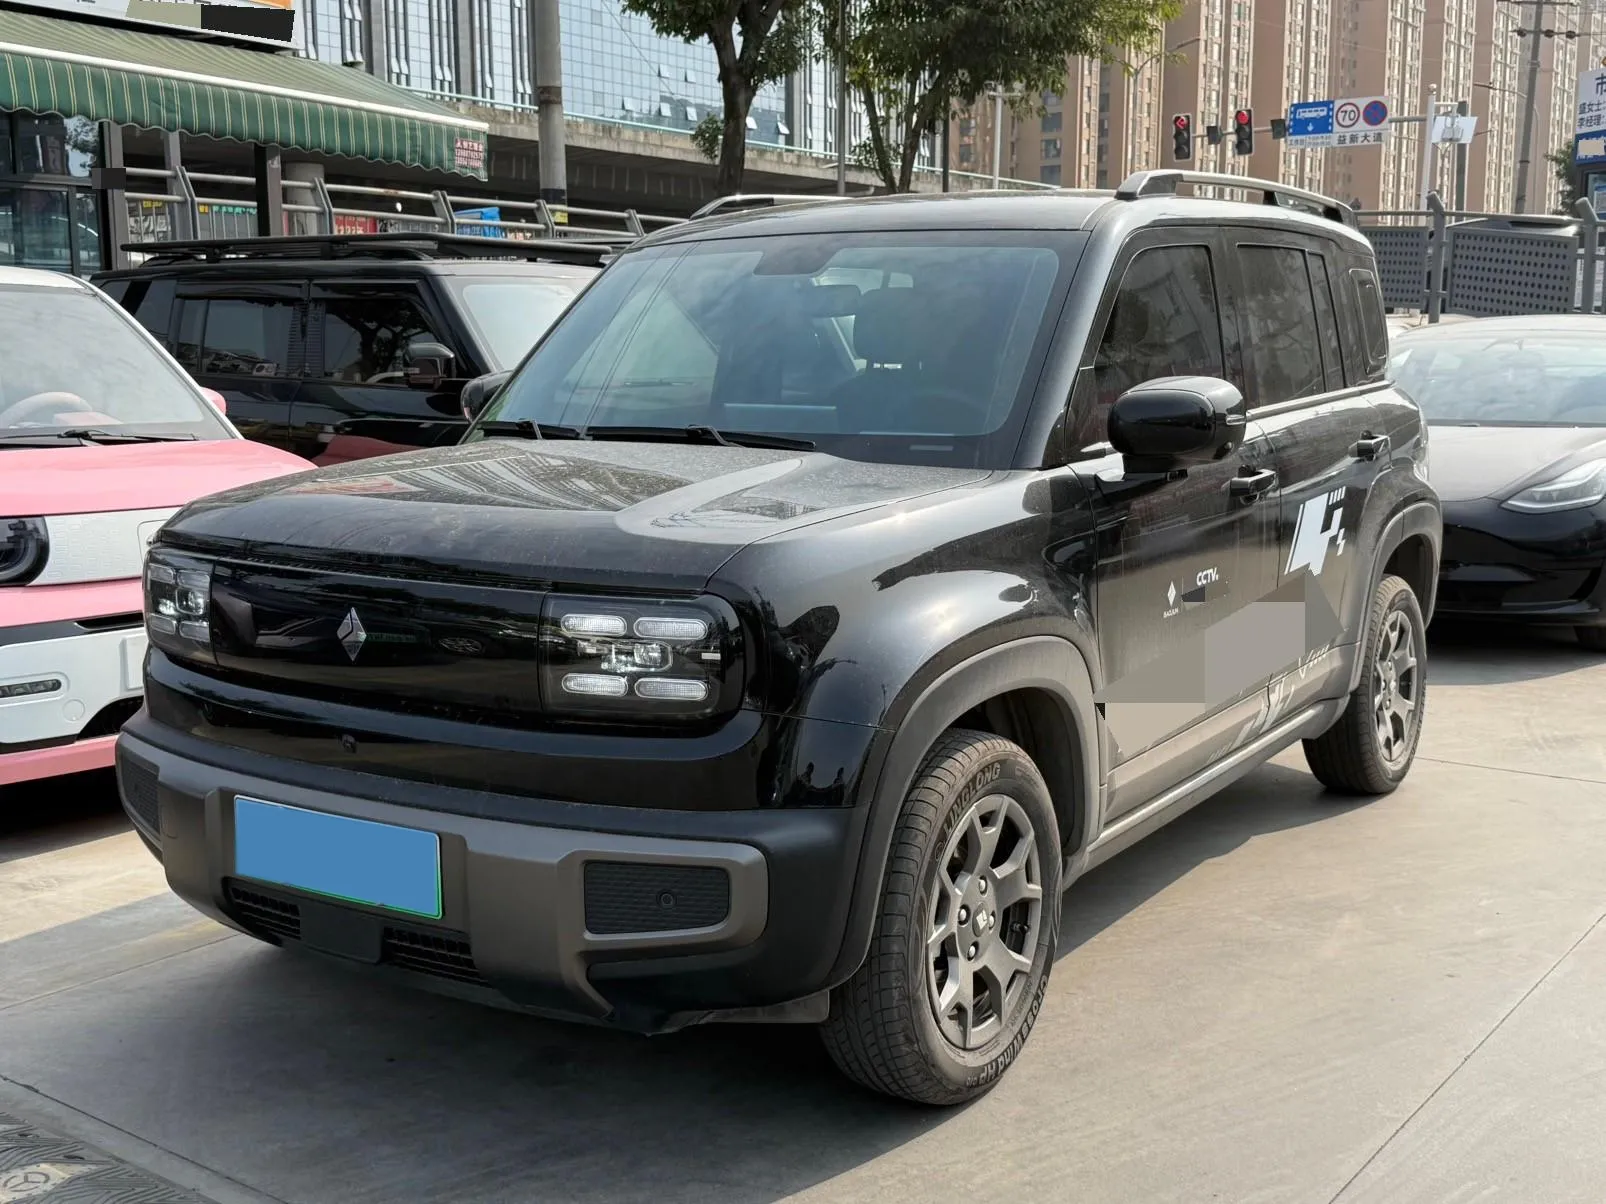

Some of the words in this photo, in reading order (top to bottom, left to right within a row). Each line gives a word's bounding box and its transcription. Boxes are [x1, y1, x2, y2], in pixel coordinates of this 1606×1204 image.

[1340, 109, 1357, 123] 70
[1337, 132, 1384, 145] 益新大道
[943, 762, 1001, 835] LINGLONG
